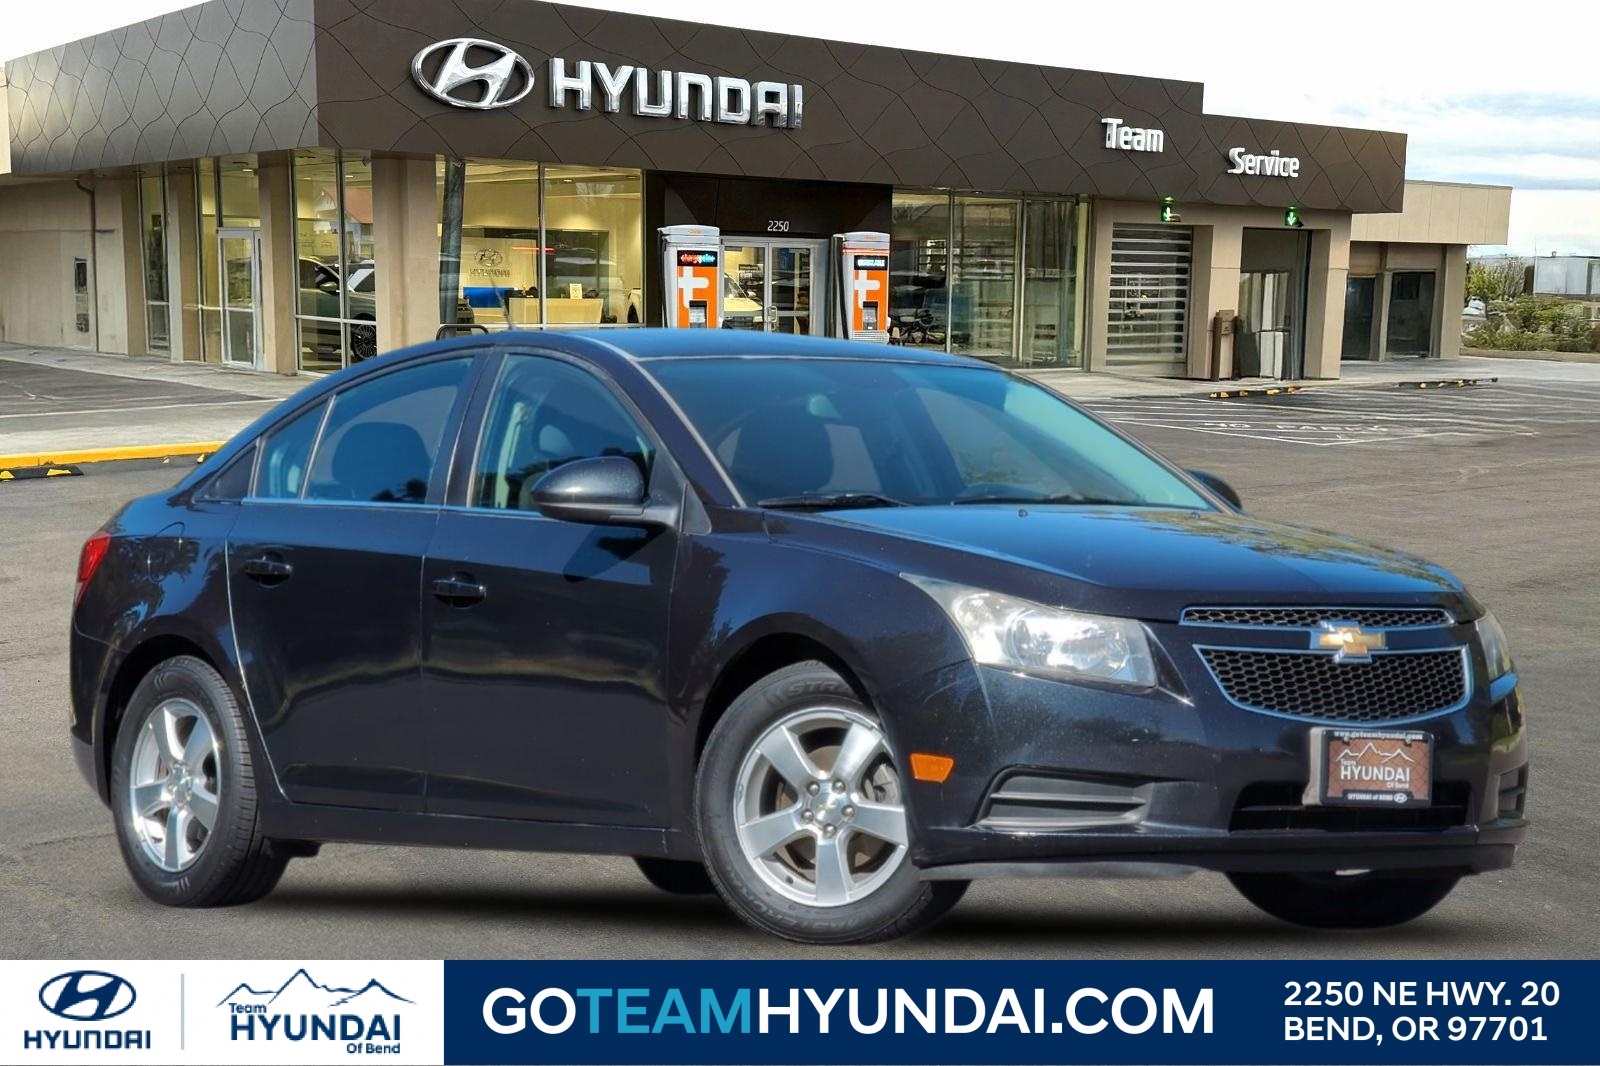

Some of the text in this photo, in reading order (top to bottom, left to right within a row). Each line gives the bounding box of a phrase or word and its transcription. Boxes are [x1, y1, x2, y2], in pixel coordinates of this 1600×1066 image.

[549, 57, 803, 129] HYUNDAI
[1101, 117, 1164, 152] Team
[1227, 147, 1301, 178] Service
[767, 220, 790, 232] 2250
[1340, 765, 1410, 782] HYUNDAI
